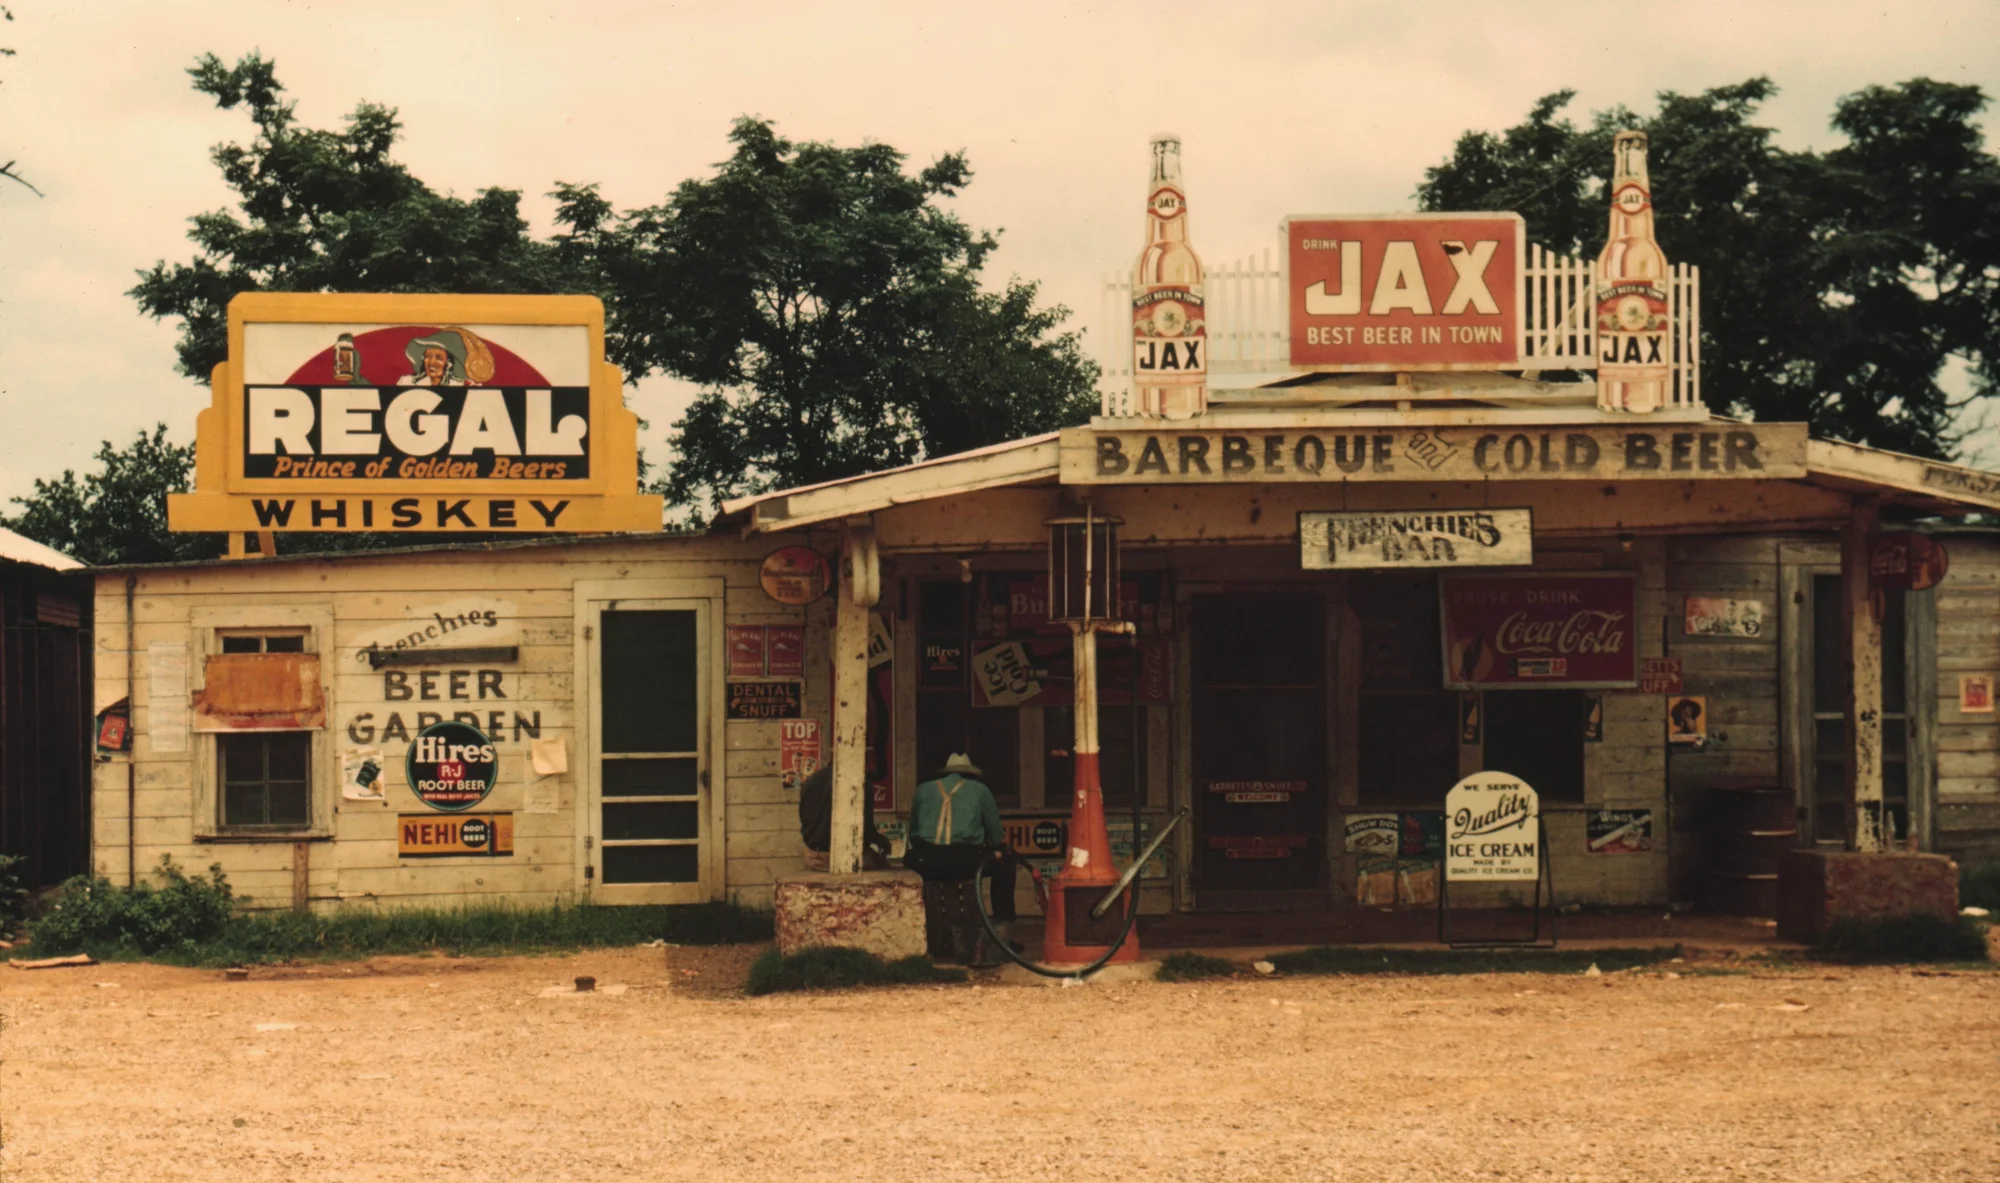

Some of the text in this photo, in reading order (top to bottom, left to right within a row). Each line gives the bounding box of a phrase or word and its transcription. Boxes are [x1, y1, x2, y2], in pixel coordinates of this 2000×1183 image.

[1303, 239, 1337, 250] DRINK
[1304, 239, 1502, 316] JAX
[1307, 326, 1502, 345] BEST BEER IN TOWN
[1139, 341, 1199, 369] JAX
[1603, 336, 1661, 363] JAX
[248, 388, 588, 456] REGAL
[1095, 431, 1763, 476] BARBEQUE and COLD BEER
[274, 457, 566, 479] Prince of Golden Beers
[252, 500, 570, 528] WHISKEY
[1382, 536, 1458, 562] BAR
[1526, 589, 1581, 604] DRINK
[1496, 610, 1626, 655] Coca-Cola
[927, 645, 960, 657] Hires
[384, 670, 508, 701] BEER
[733, 684, 794, 697] DENTAL
[984, 661, 1008, 697] Ice
[739, 704, 789, 717] SNUFF
[783, 722, 817, 739] TOP
[415, 736, 494, 763] Hires
[418, 780, 486, 791] ROOT BEER
[1347, 820, 1377, 834] SHOW
[1451, 794, 1531, 839] Quality
[404, 824, 457, 845] NEHI
[1449, 843, 1535, 857] ICE CREAM
